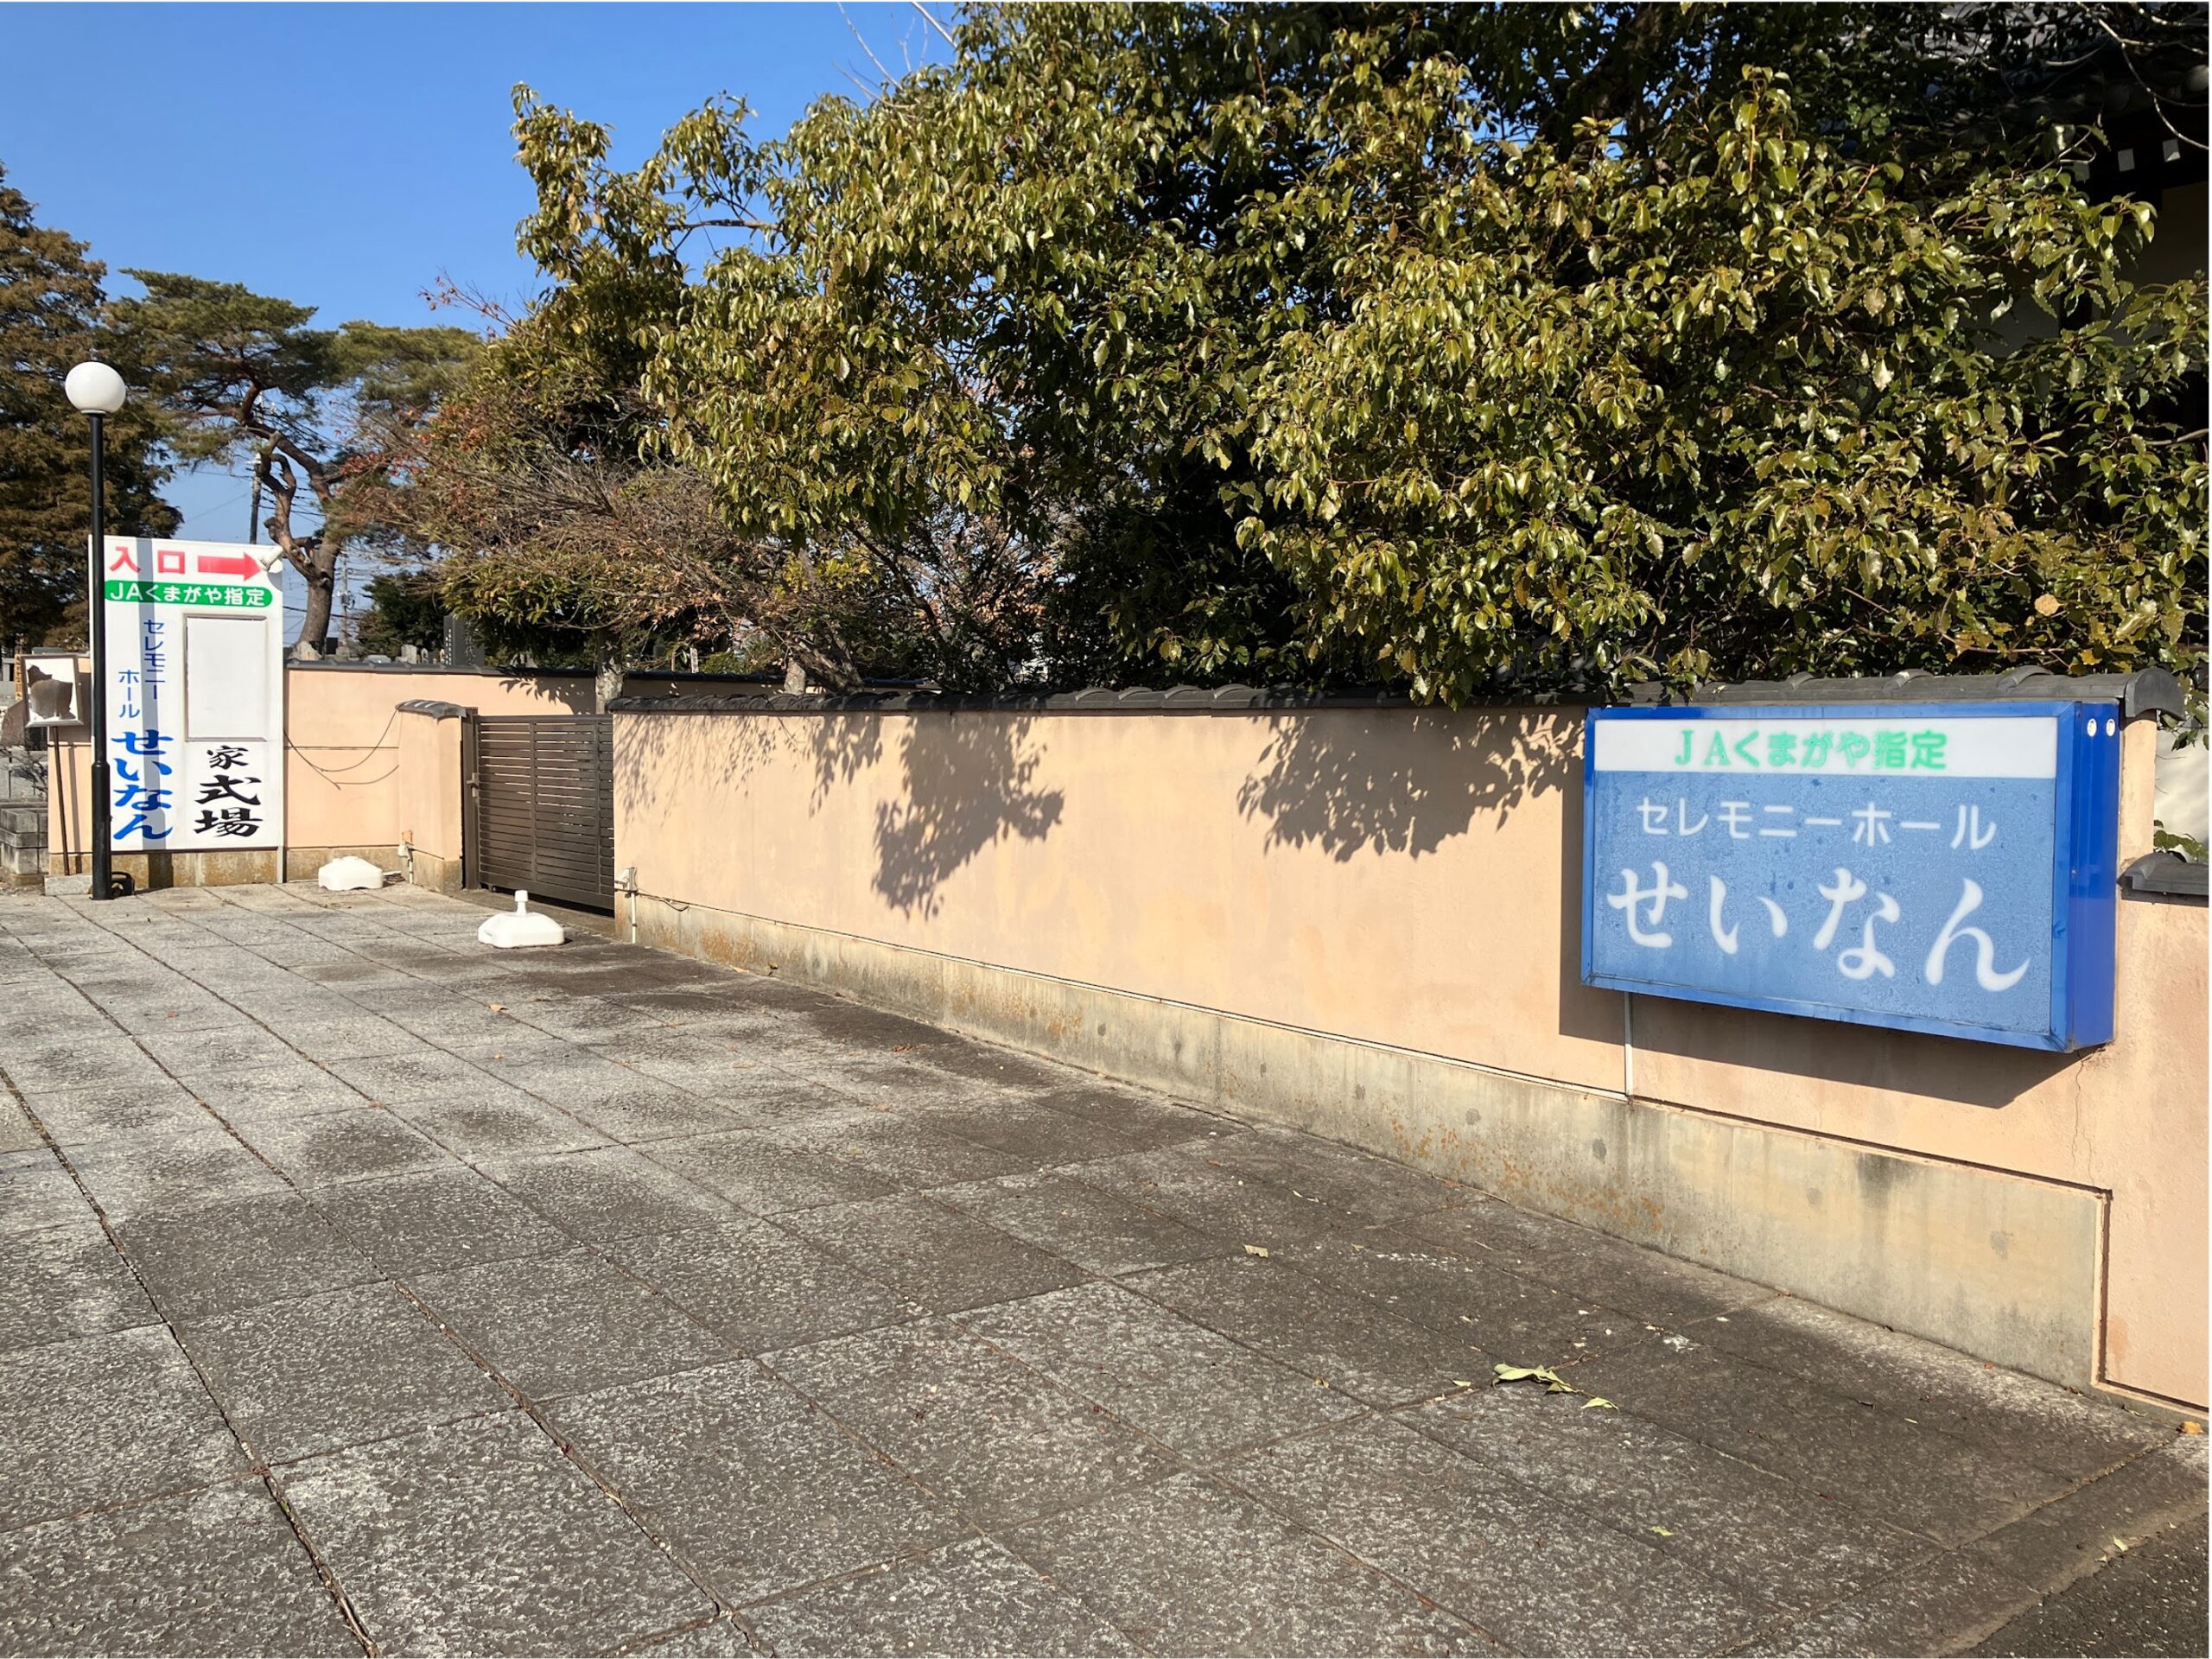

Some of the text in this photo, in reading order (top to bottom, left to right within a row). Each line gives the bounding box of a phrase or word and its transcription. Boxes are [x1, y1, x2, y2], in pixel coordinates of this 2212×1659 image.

[109, 546, 186, 575] 入口
[110, 582, 265, 607] JAくまがや指定
[143, 619, 167, 700] セレモニー
[118, 669, 141, 719] ホール
[1675, 728, 1948, 771] JAくまがや指定
[111, 728, 175, 841] せいなん
[193, 745, 264, 838] 家式場
[1636, 797, 1998, 850] セレモニーホール
[1606, 861, 2031, 993] せいなん
